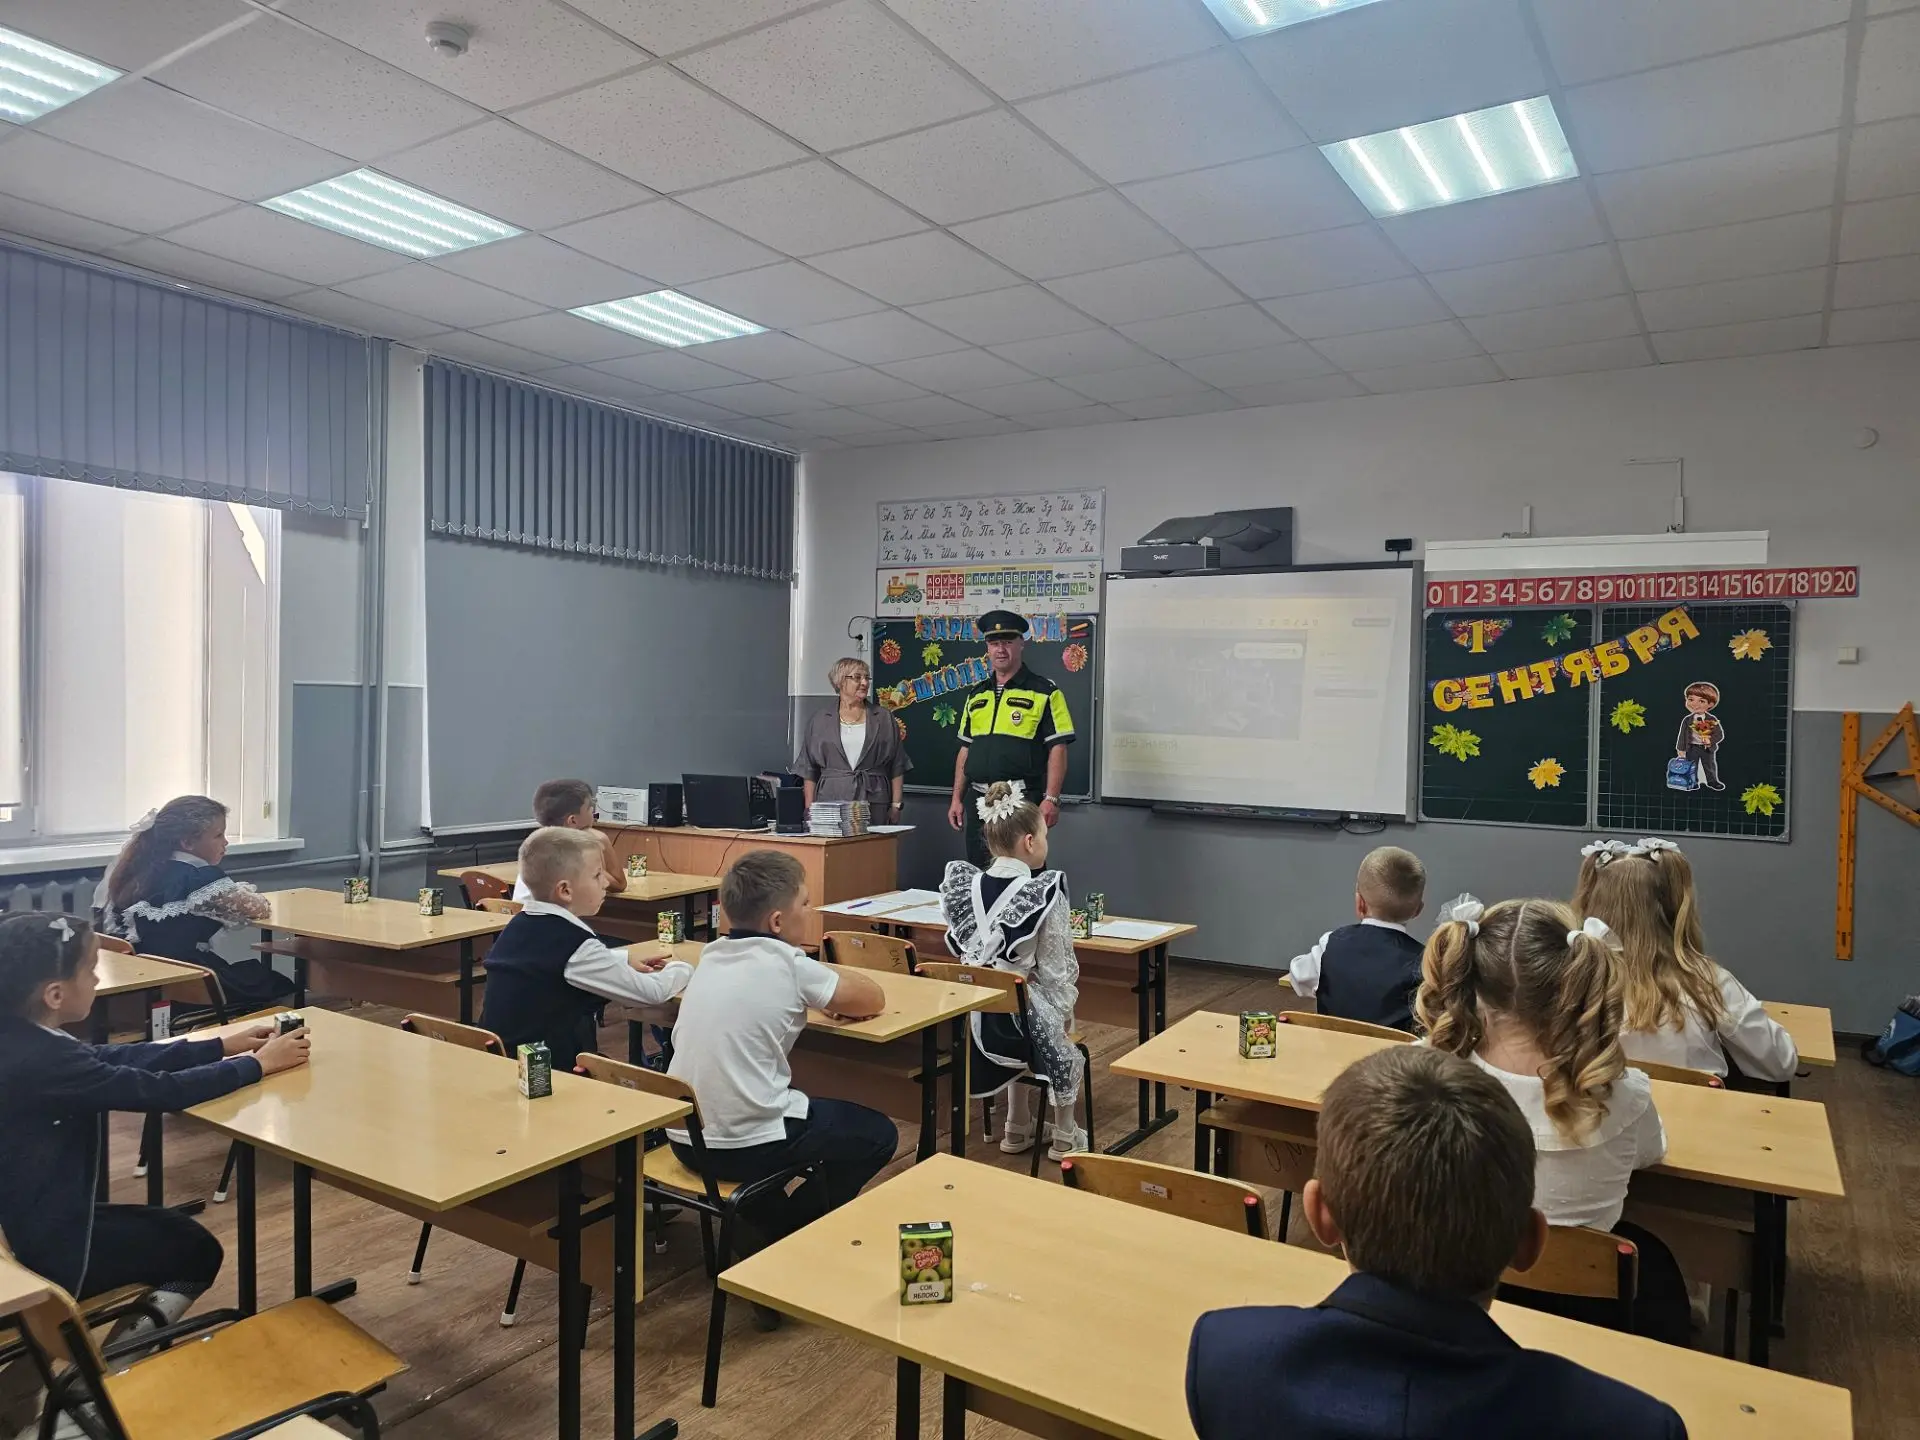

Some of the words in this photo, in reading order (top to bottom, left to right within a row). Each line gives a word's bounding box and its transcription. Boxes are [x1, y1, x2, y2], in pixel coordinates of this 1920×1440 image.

[1428, 586, 1442, 604] 0
[1449, 585, 1458, 604] 1
[1464, 584, 1478, 604] 2
[1482, 583, 1497, 603] 3
[1500, 583, 1516, 603] 4
[1520, 582, 1534, 602] 5
[1538, 581, 1554, 601] 6
[1558, 581, 1573, 601] 7
[1577, 580, 1593, 600] 8
[1597, 579, 1613, 599] 9
[1617, 578, 1635, 599] 10
[1638, 577, 1654, 598] 11
[1658, 576, 1677, 597] 12
[1679, 575, 1697, 597] 13
[1700, 575, 1719, 596] 14
[1722, 574, 1741, 595] 15
[1743, 573, 1764, 595] 16
[1766, 572, 1788, 594] 17
[1788, 571, 1809, 594] 18
[1812, 571, 1833, 593] 19
[1834, 570, 1856, 593] 20
[1468, 619, 1487, 654] 1
[1432, 605, 1700, 712] СЕНТЯБРЯ
